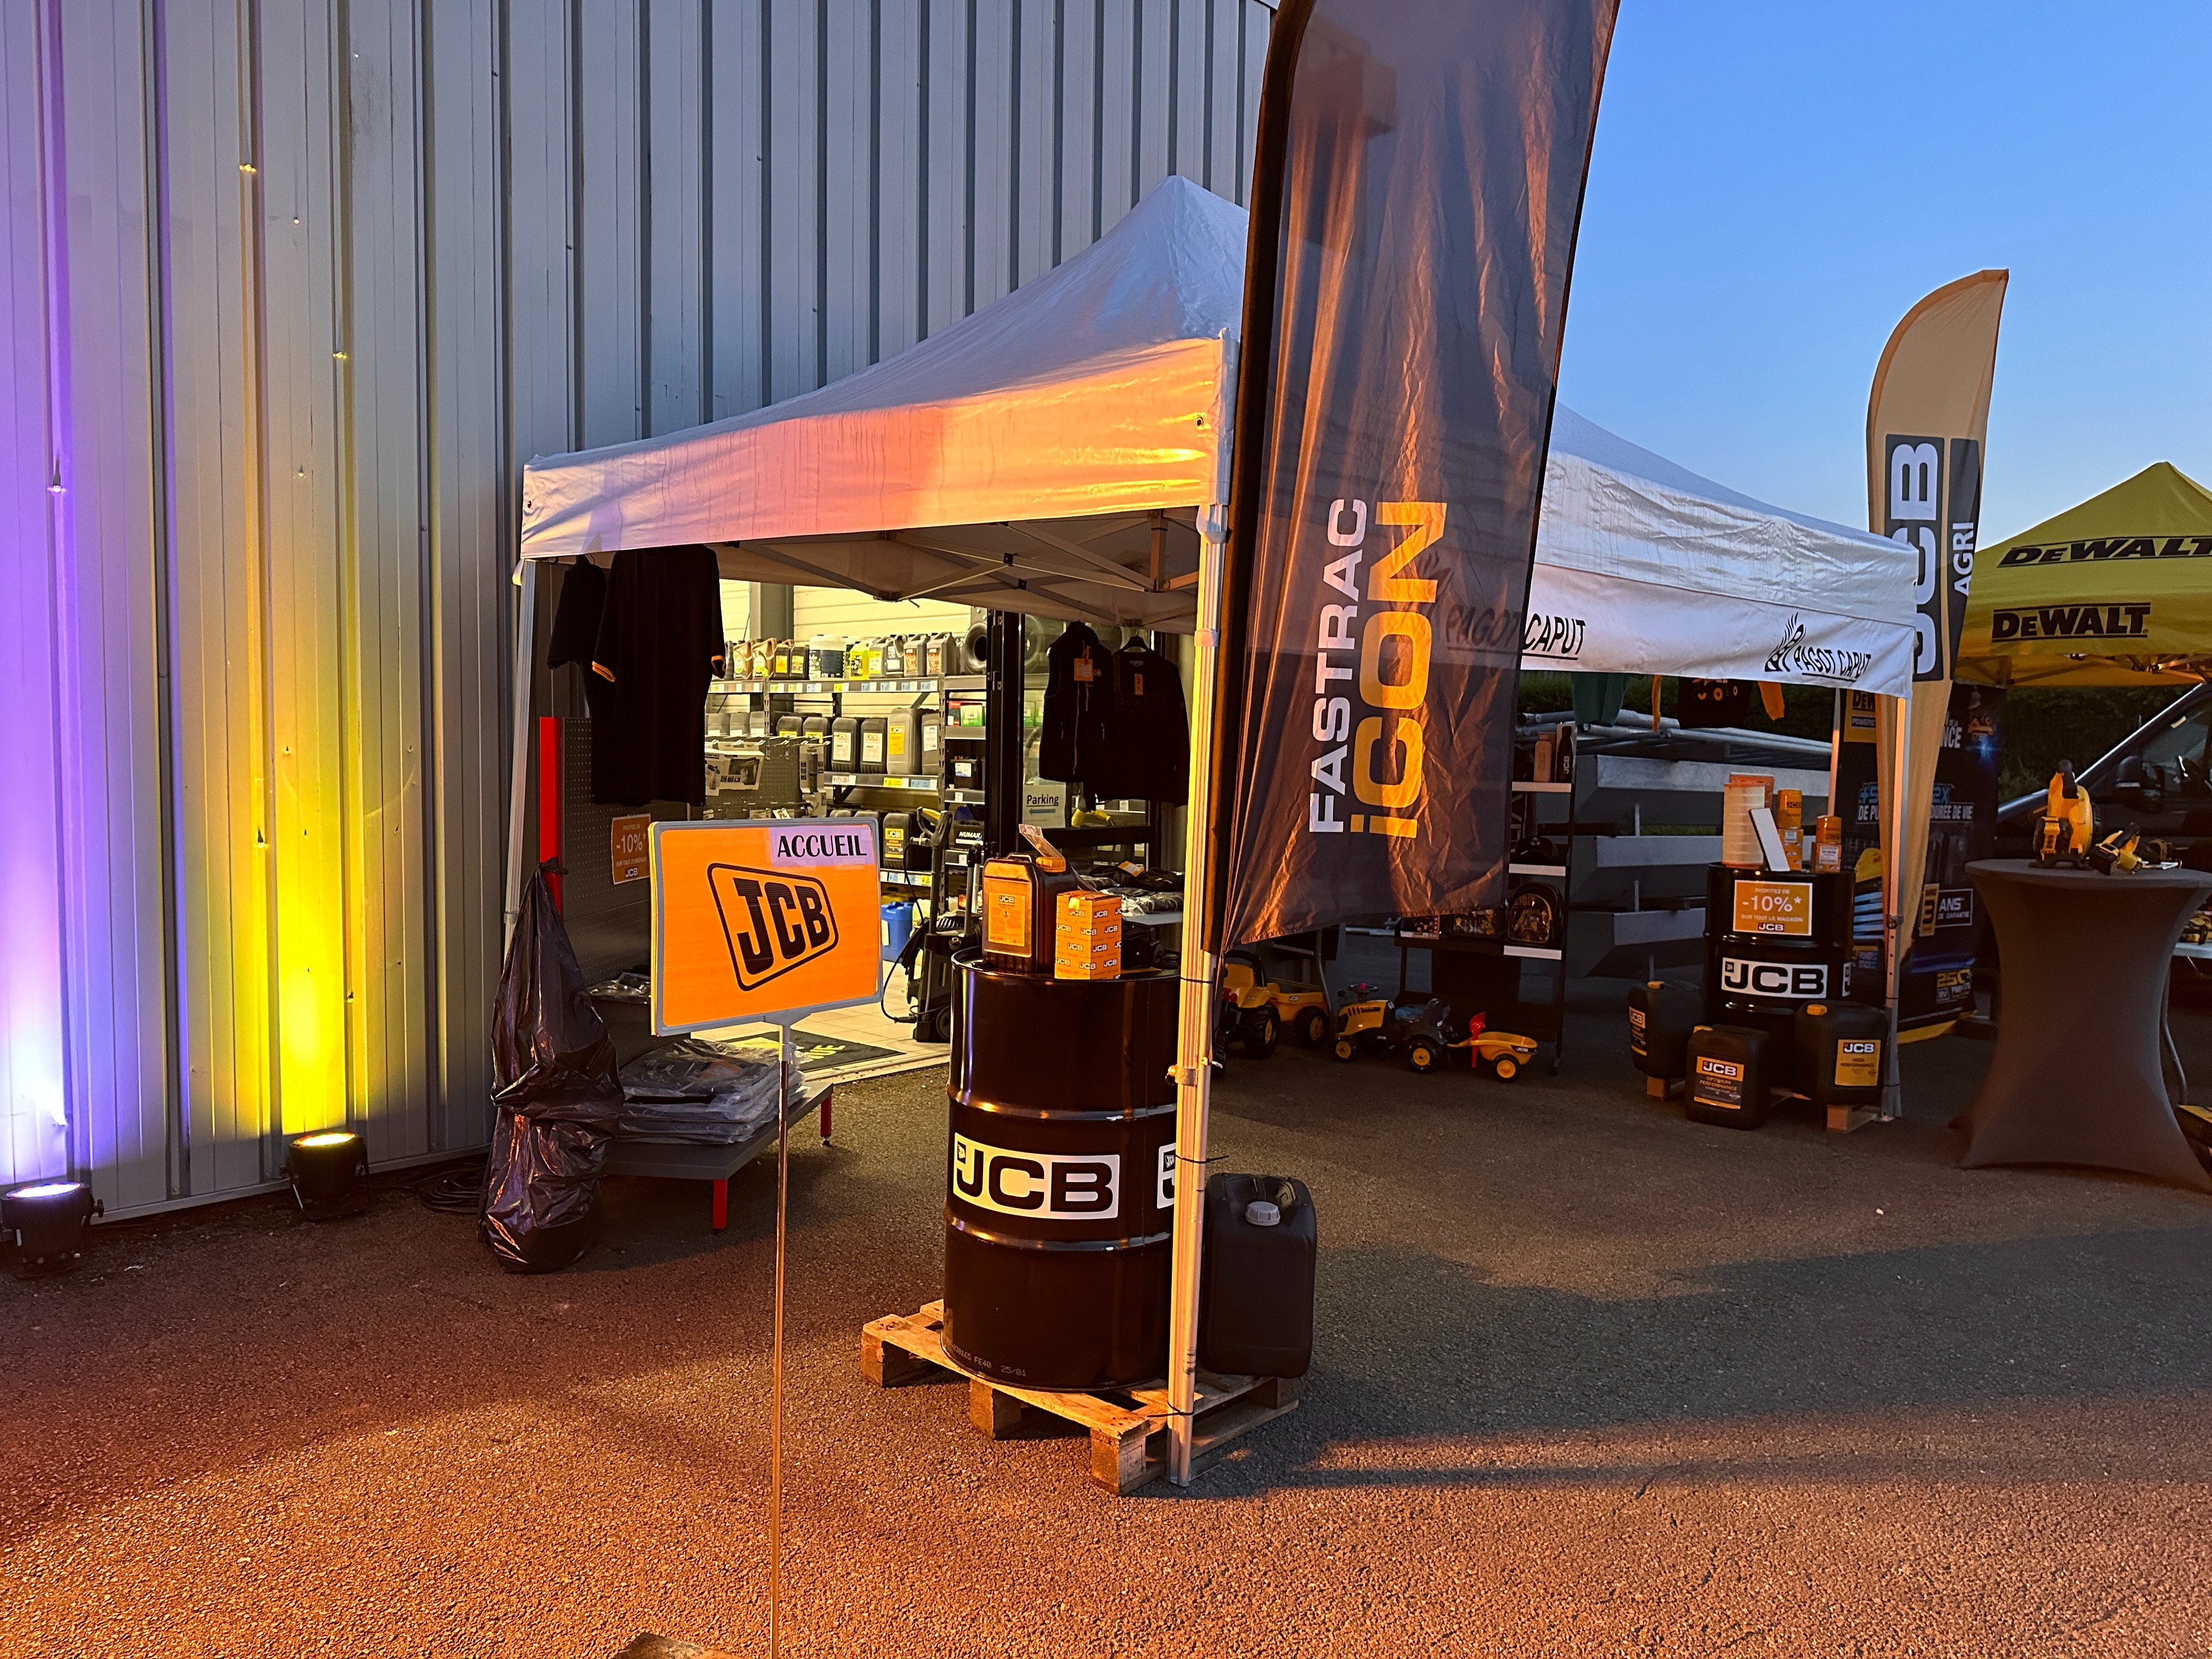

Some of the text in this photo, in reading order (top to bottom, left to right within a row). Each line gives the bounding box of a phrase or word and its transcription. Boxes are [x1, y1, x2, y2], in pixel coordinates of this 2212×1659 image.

[1952, 522, 1974, 596] AGRI
[1992, 606, 2151, 638] DEWALT
[1522, 613, 1586, 654] CAPUT
[1309, 499, 1367, 833] FASTRAC
[1793, 645, 1871, 679] PAGOT CAPUT
[1350, 501, 1447, 839] iCON
[1026, 793, 1059, 806] Parking
[887, 830, 901, 838] JCB
[958, 831, 981, 839] NUMAX
[777, 834, 867, 857] ACCUEIL
[625, 867, 638, 878] JCB
[1938, 897, 1965, 912] ANS
[1093, 910, 1108, 918] JCB
[732, 877, 830, 975] JCB
[1104, 925, 1118, 933] JCB
[1067, 943, 1084, 951] JCB
[1092, 944, 1108, 952] JCB
[1104, 959, 1117, 967] JCB
[1724, 963, 1824, 995] JCB
[1844, 1043, 1875, 1053] JCB
[1703, 1062, 1736, 1076] JCB
[956, 1148, 1114, 1213] JCB
